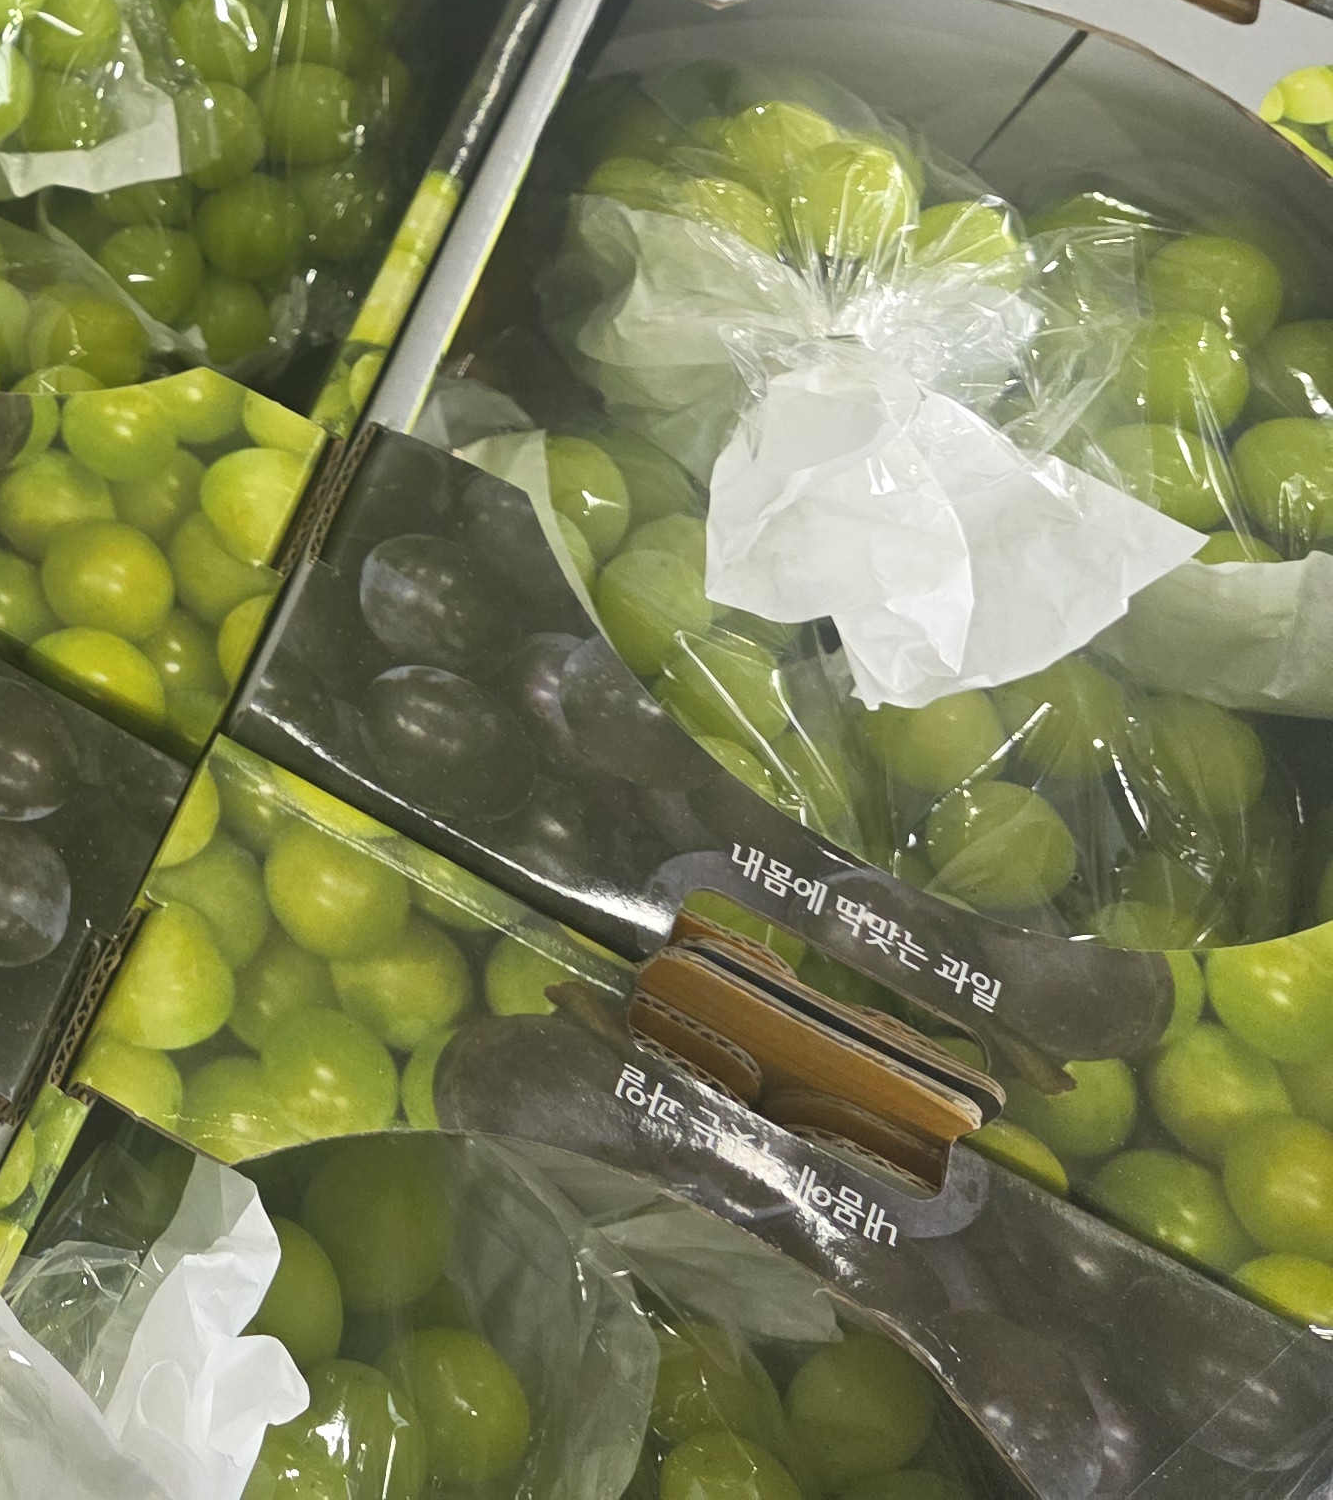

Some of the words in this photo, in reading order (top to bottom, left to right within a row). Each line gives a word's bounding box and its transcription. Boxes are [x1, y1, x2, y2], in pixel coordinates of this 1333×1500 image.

[731, 843, 829, 917] 내몸에
[836, 894, 930, 972] 딱맞는
[933, 954, 1002, 1014] 과일
[614, 1062, 684, 1123] 과일
[794, 1165, 899, 1248] 내몸에
